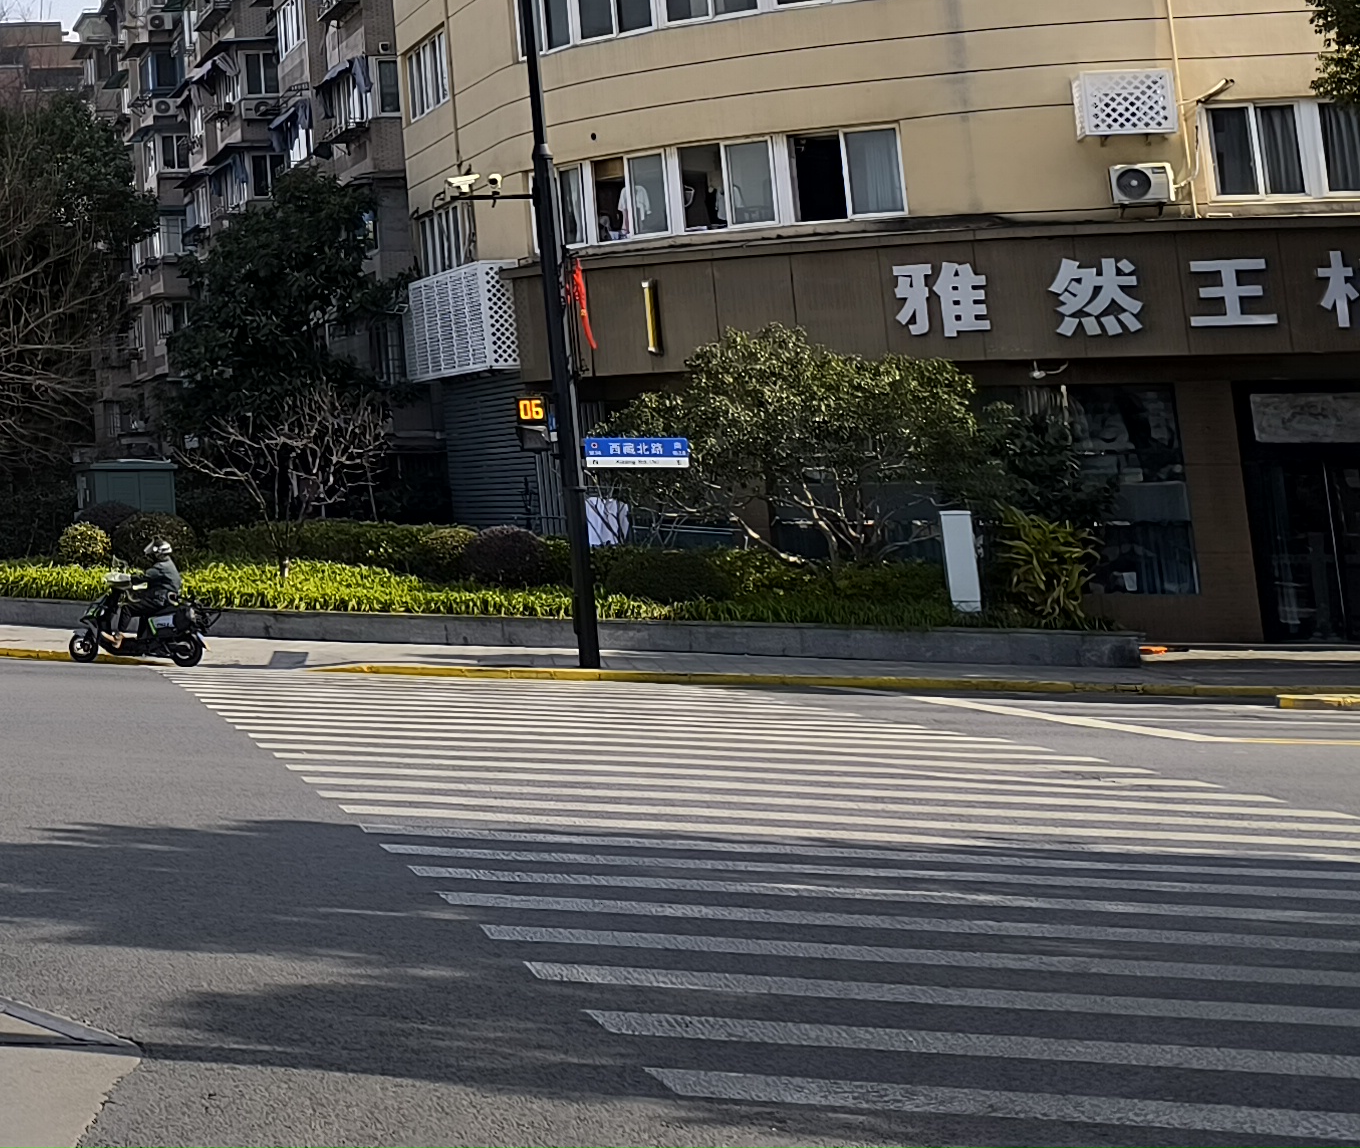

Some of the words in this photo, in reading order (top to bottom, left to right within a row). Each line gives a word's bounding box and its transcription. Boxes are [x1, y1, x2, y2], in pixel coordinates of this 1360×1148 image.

[519, 399, 544, 420] 06
[608, 442, 664, 455] 西藏北路
